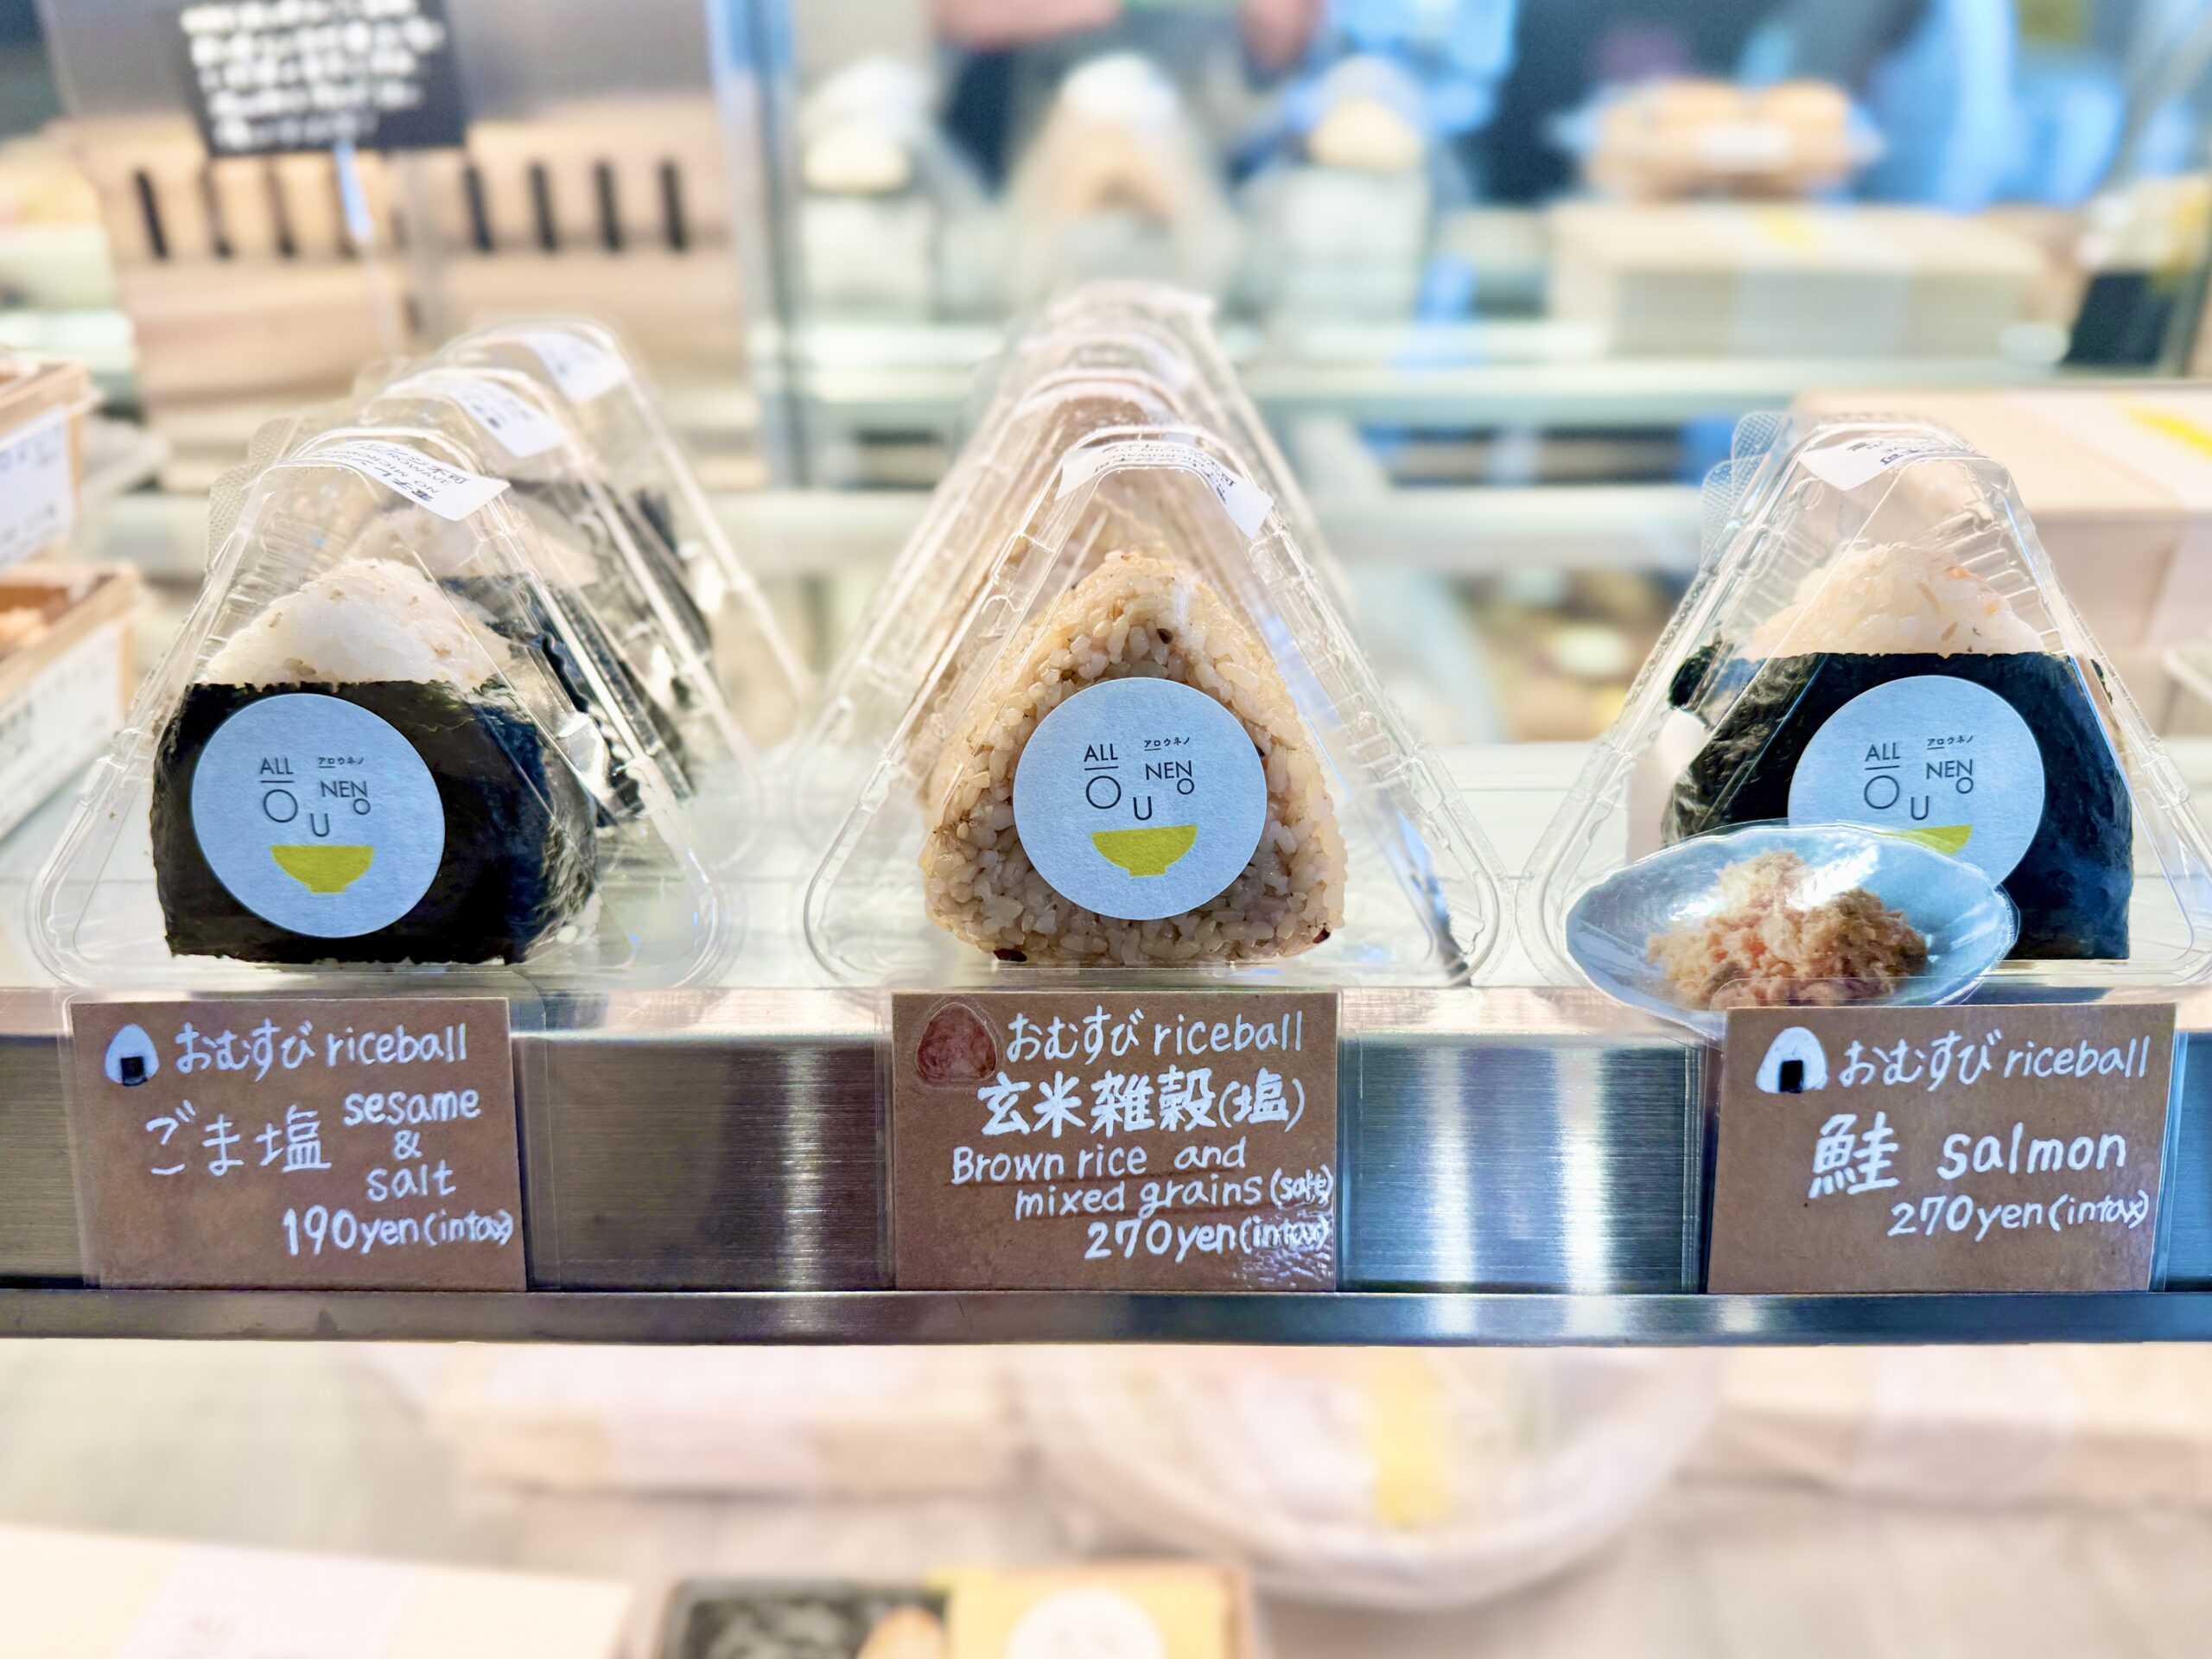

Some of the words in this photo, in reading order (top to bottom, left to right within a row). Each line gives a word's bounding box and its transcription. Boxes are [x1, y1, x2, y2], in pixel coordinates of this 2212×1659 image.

[260, 758, 294, 775] ALL
[1084, 744, 1118, 762] ALL
[1146, 760, 1192, 779] NEN
[1865, 743, 1900, 761] ALL
[1926, 760, 1973, 779] NEN
[321, 780, 368, 798] NEN
[176, 1018, 314, 1082] おむすび
[327, 1024, 467, 1068] riceball
[1006, 1005, 1144, 1065] おむすび
[1154, 1010, 1303, 1057] riceball
[1839, 1029, 2003, 1092] おむすび
[2004, 1035, 2151, 1077] riceball
[345, 1088, 481, 1127] sesame
[145, 1099, 332, 1177] ごま塩
[393, 1129, 422, 1159] &
[1808, 1110, 1900, 1199] 鮭
[1936, 1122, 2126, 1181] salmon
[951, 1146, 1064, 1185] Brown
[1077, 1142, 1147, 1178] rice
[1174, 1136, 1246, 1169] and
[366, 1160, 456, 1203] salt
[1014, 1179, 1124, 1221] mixed
[1139, 1173, 1262, 1219] grains
